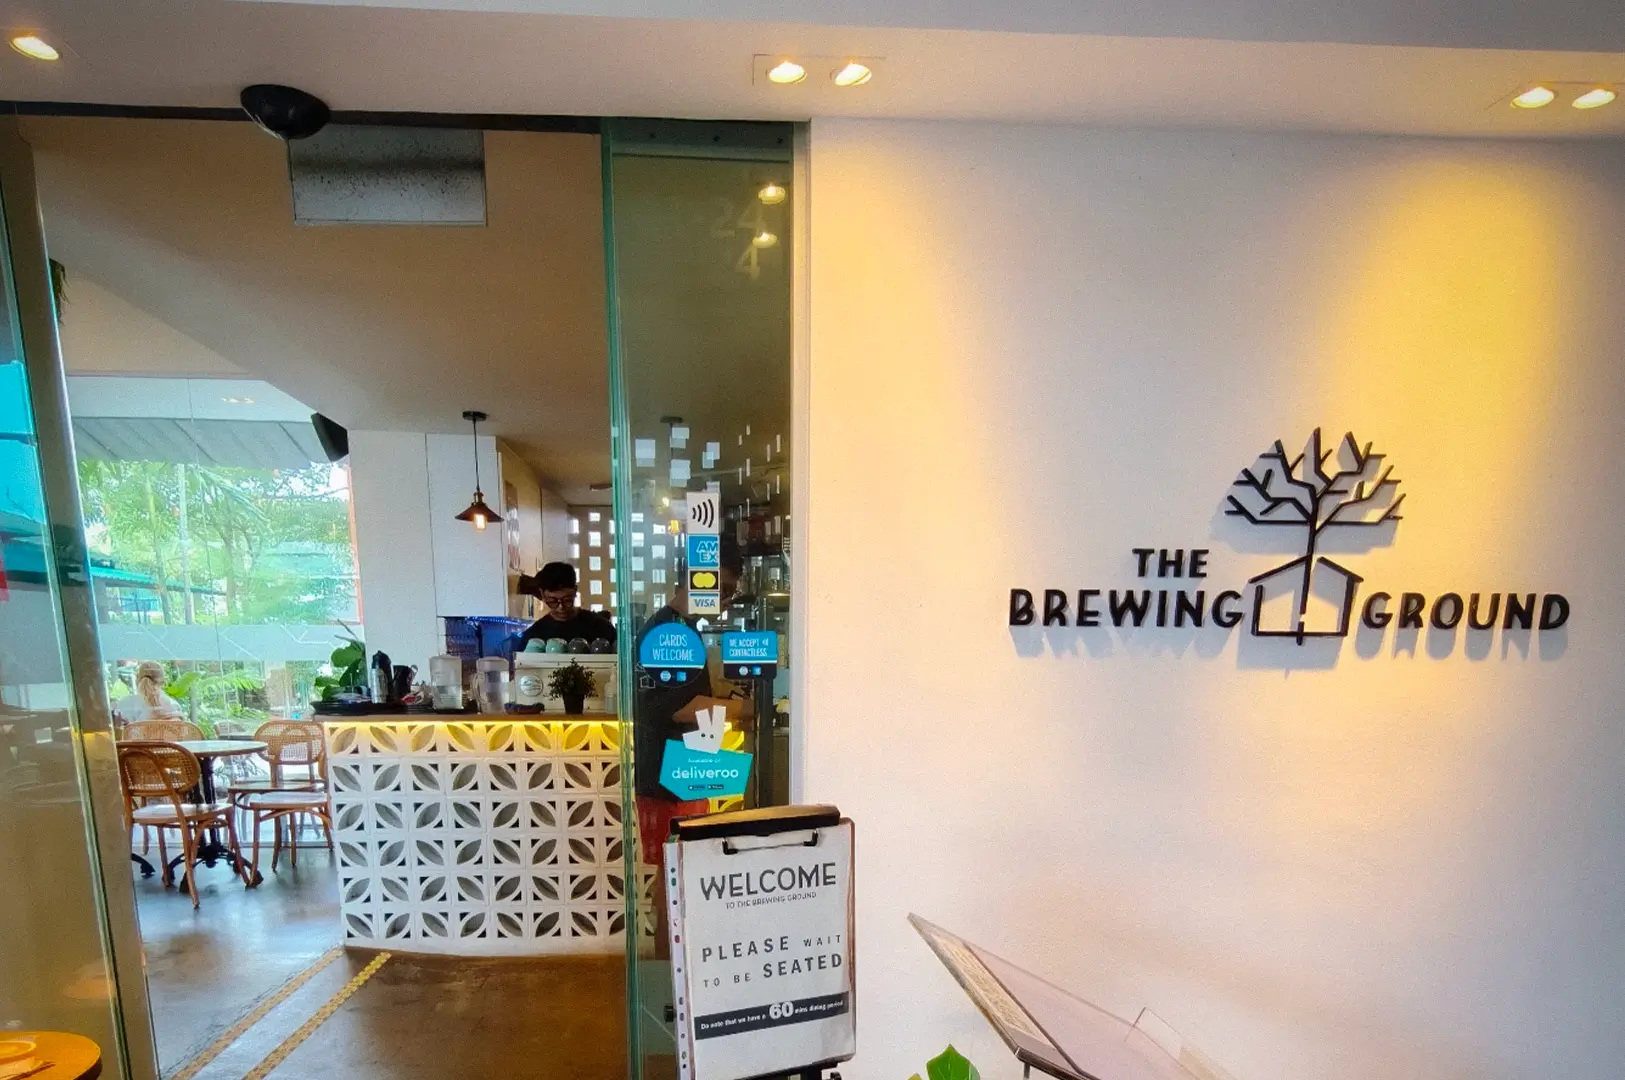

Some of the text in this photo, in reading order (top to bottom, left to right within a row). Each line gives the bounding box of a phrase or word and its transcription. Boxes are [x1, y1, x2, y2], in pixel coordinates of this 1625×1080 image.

[1132, 548, 1209, 578] THE
[694, 599, 716, 608] VISA
[1009, 589, 1570, 630] BREWING GROUND
[659, 634, 688, 647] CARDS
[739, 638, 760, 647] ACCEPT
[652, 648, 694, 662] WELCOME
[729, 648, 768, 657] CONTACTLESS
[671, 766, 739, 779] deliveroo
[700, 862, 836, 901] WELCOME
[725, 892, 817, 910] TO THE BREWING GROUND
[702, 935, 842, 963] PLEASE WAIT
[703, 953, 842, 988] TO BE SEATED
[701, 1022, 710, 1030] Do
[769, 1001, 794, 1020] 60
